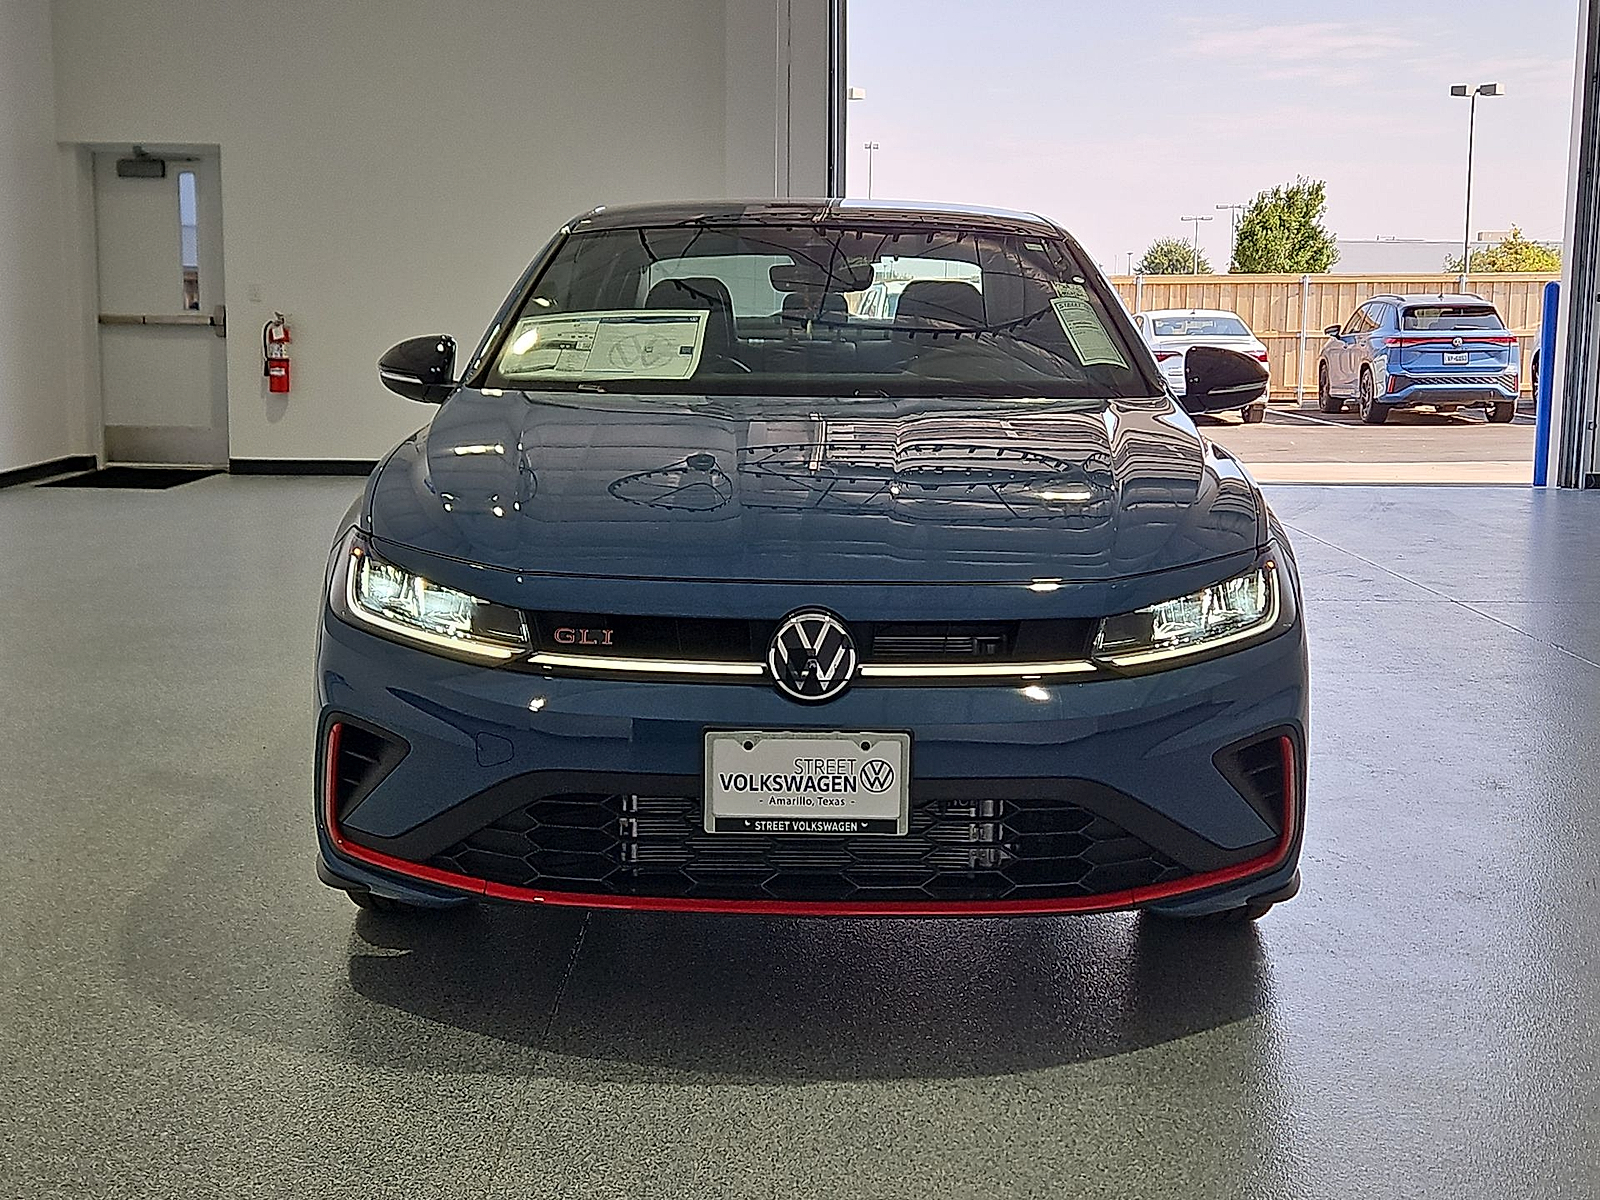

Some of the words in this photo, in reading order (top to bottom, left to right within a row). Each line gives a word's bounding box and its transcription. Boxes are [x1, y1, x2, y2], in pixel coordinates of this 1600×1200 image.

[554, 627, 613, 645] GLI
[794, 758, 857, 775] STREET
[719, 773, 857, 793] VOLKSWAGEN
[768, 796, 815, 807] Amarillo,
[817, 796, 846, 806] Texas
[754, 820, 790, 831] STREET
[792, 821, 858, 832] VOLKSWAGEN
